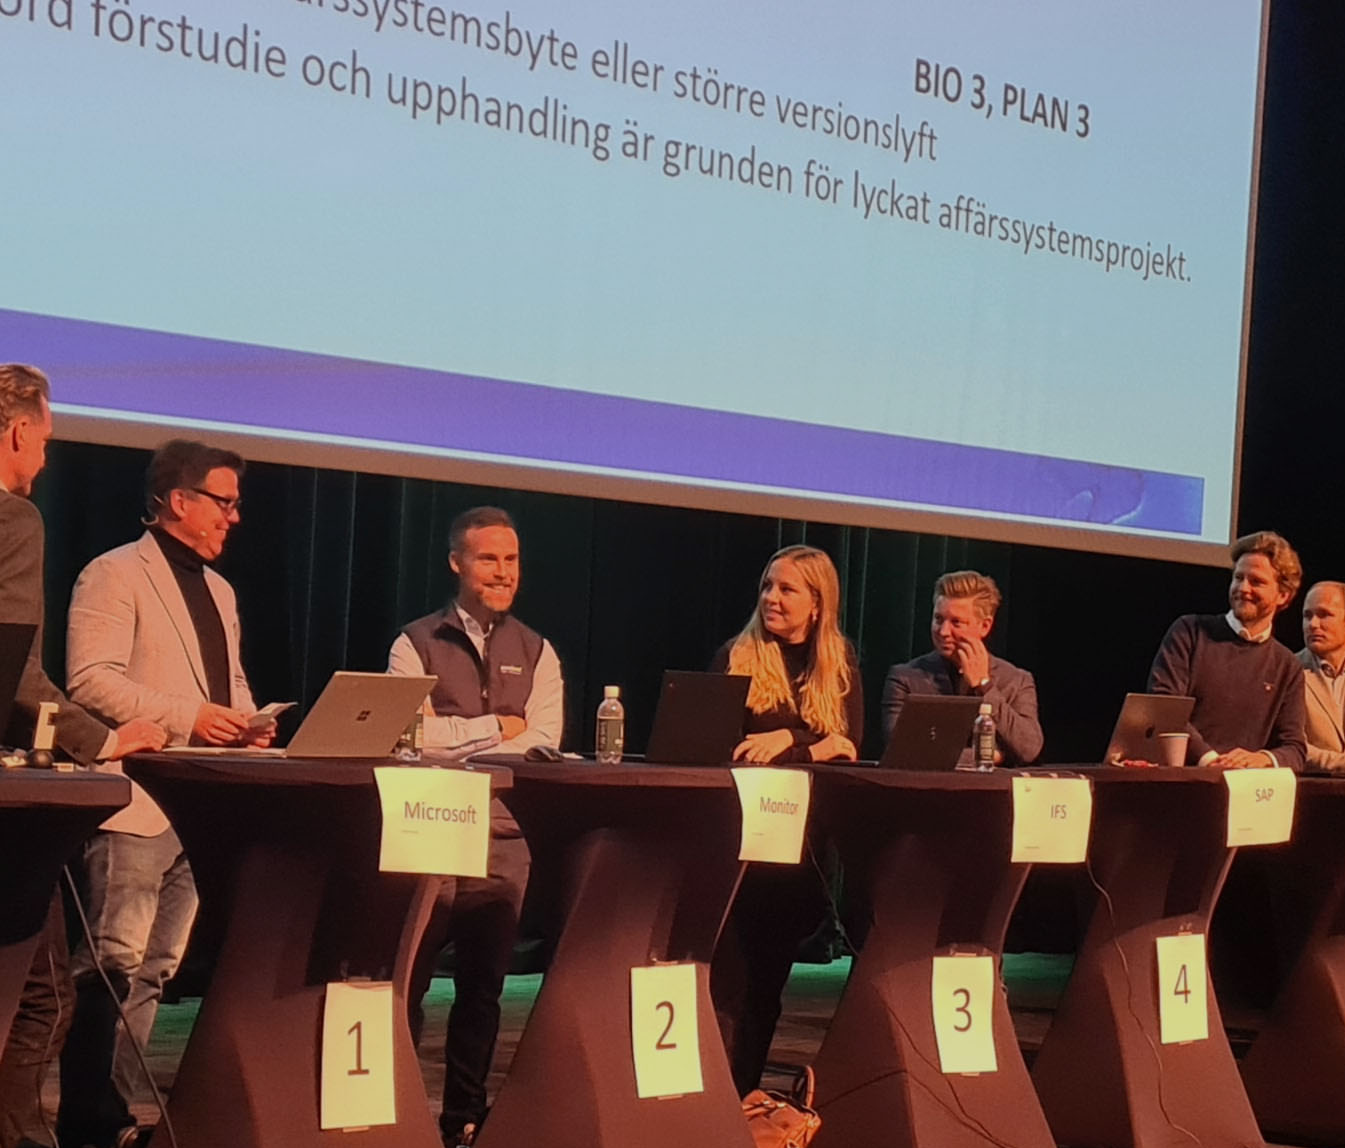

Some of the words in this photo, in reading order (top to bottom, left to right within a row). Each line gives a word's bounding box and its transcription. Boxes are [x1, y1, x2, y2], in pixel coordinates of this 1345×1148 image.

[591, 39, 665, 92] eller
[673, 65, 766, 118] större
[775, 94, 938, 164] versionslyft
[914, 57, 963, 104] BIO
[970, 73, 993, 120] 3,
[1002, 82, 1069, 133] PLAN
[1075, 103, 1090, 139] 3
[90, 0, 287, 78] förstudie
[301, 48, 371, 99] och
[387, 72, 612, 162] upphandling
[621, 118, 656, 162] är
[662, 139, 793, 195] grunden
[803, 158, 844, 205] för
[853, 169, 931, 225] lyckat
[938, 194, 1191, 283] affärssystemsprojekt.
[404, 800, 477, 825] Microsoft
[760, 796, 799, 815] Monitor
[1050, 804, 1067, 819] IFS
[1255, 787, 1274, 803] SAP
[1173, 963, 1192, 1004] 4
[655, 1000, 678, 1051] 2
[952, 987, 973, 1033] 3
[346, 1020, 371, 1077] 1
